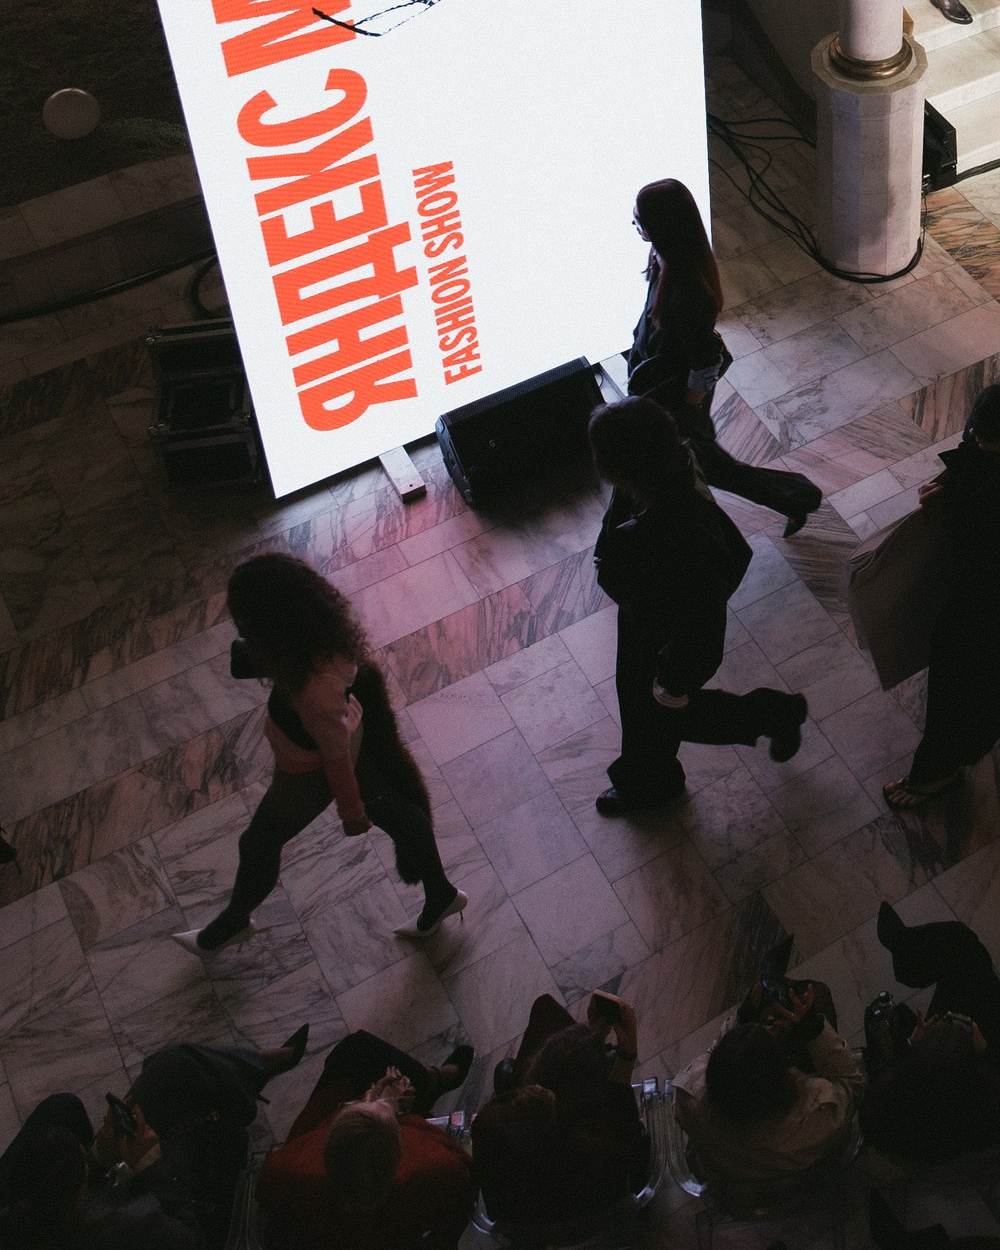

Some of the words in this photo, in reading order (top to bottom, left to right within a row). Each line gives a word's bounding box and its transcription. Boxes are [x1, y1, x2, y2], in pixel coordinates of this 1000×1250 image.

[236, 67, 419, 432] ЯНДЕКС
[411, 160, 465, 258] SHOW
[427, 256, 483, 386] FASHION
